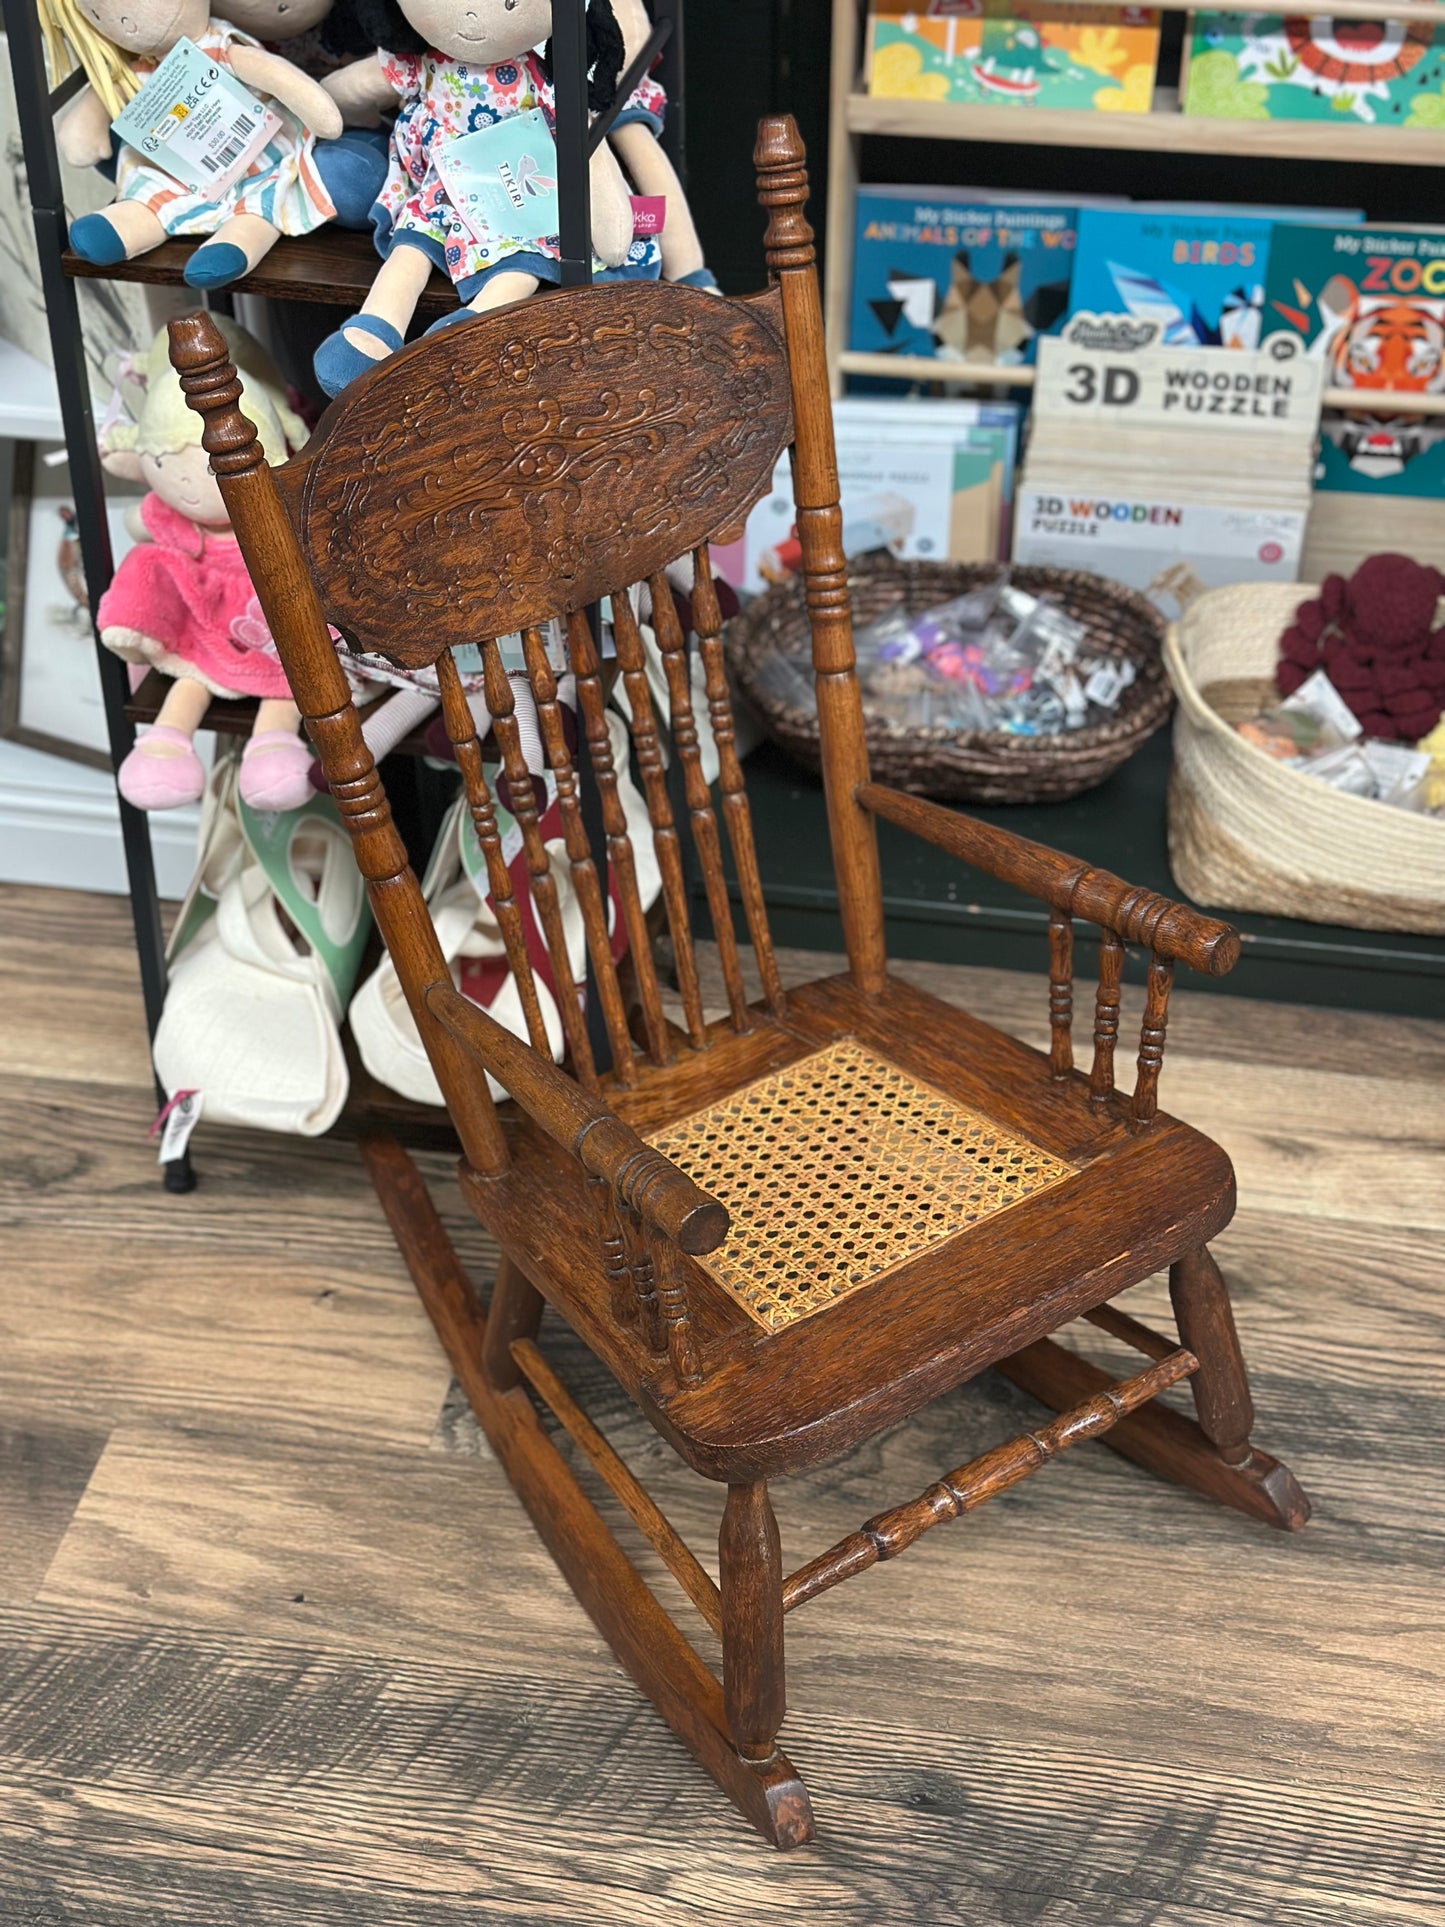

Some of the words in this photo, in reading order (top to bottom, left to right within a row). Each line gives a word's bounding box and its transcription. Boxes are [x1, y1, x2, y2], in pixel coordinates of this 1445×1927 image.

[499, 162, 525, 208] TIKIRI
[915, 206, 939, 224] My
[942, 208, 992, 226] Sticker
[995, 211, 1066, 229] Paintings
[864, 220, 958, 245] ANIMALS
[961, 227, 992, 247] OF
[997, 228, 1035, 248] THE
[1334, 234, 1360, 255] My
[1362, 235, 1415, 256] Sticker
[1172, 239, 1255, 267] BIRDS
[1065, 363, 1141, 407] 3D
[1165, 369, 1293, 395] WOODEN
[1163, 391, 1290, 418] PUZZLE
[1035, 496, 1064, 516] 3D
[1068, 498, 1183, 526] WOODEN
[1032, 518, 1098, 536] PUZZLE
